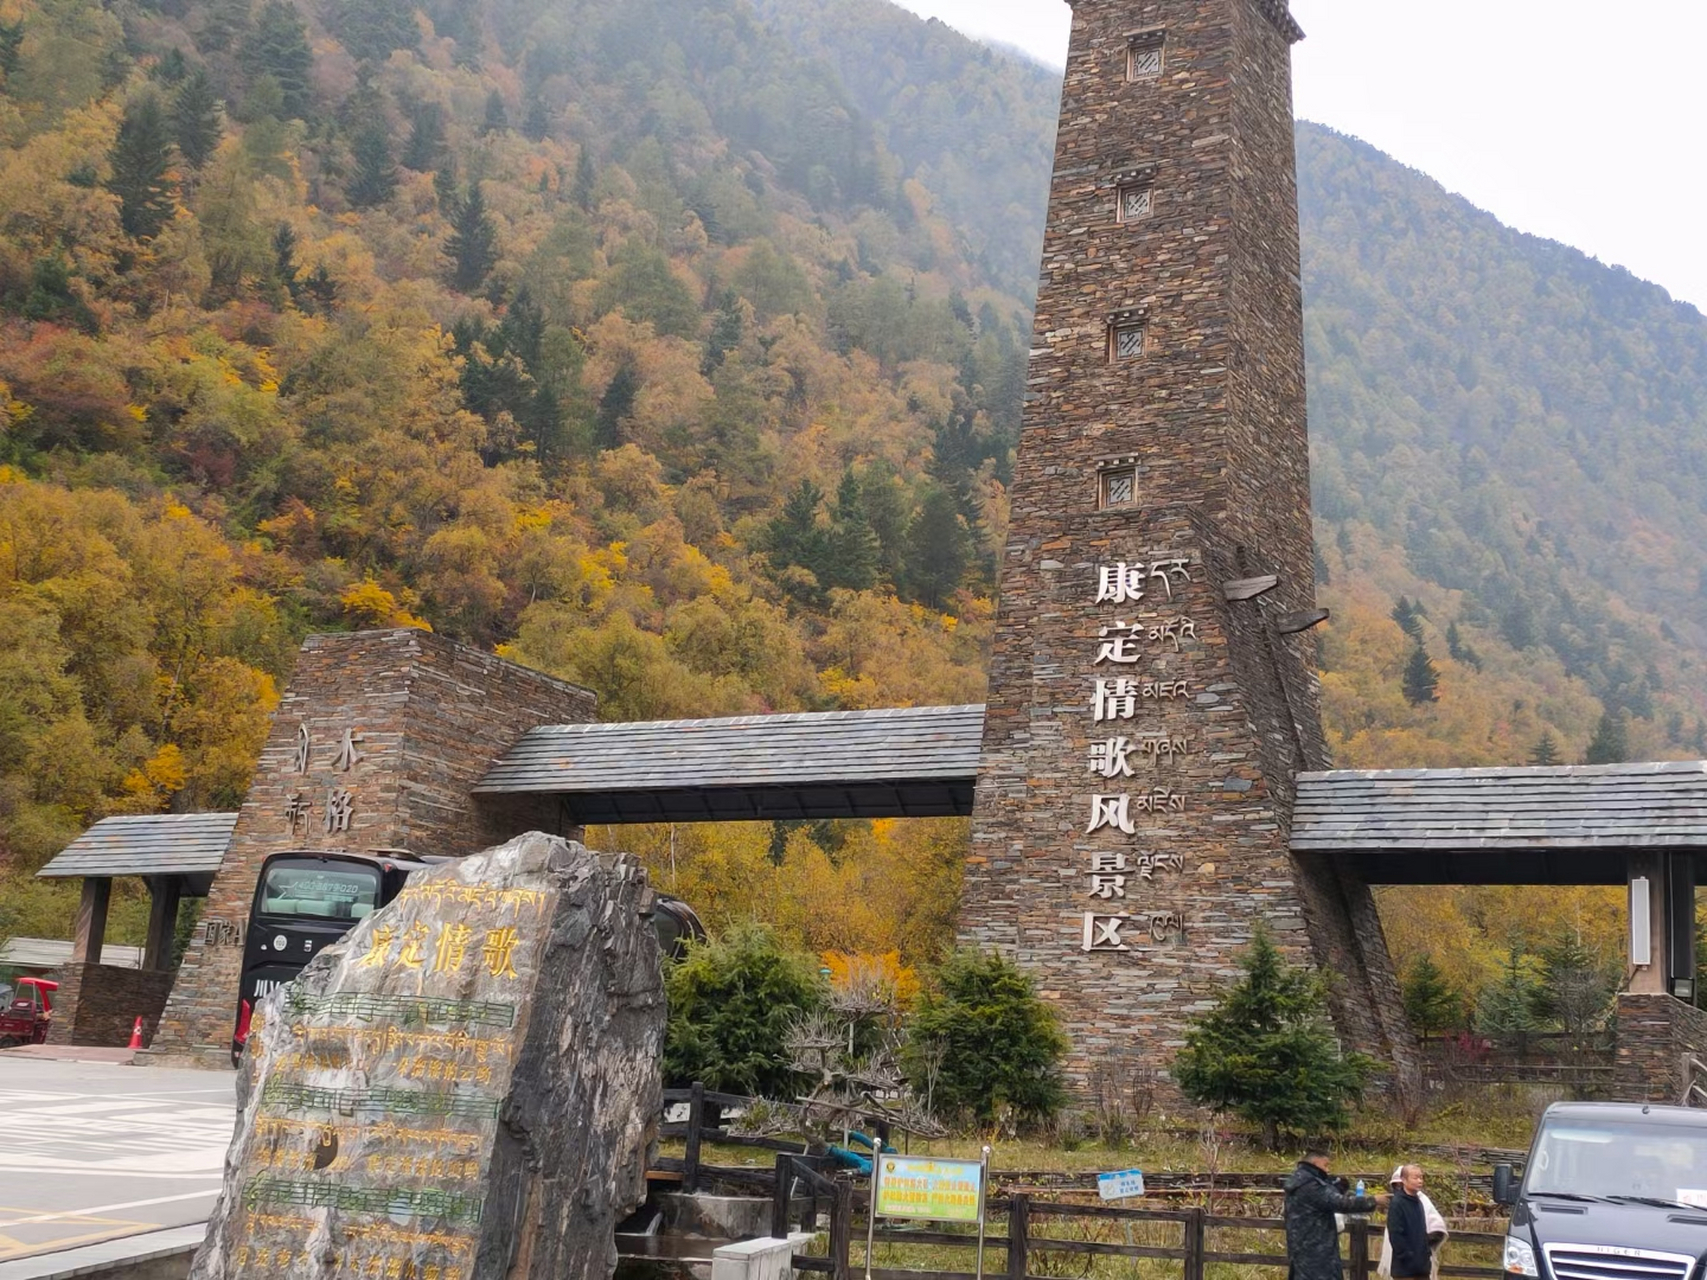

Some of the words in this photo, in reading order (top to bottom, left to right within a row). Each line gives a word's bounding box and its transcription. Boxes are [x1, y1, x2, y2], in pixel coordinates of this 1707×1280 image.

[324, 727, 362, 852] 木格
[1081, 561, 1146, 952] 康定情歌风景区
[357, 920, 519, 980] 康定情歌
